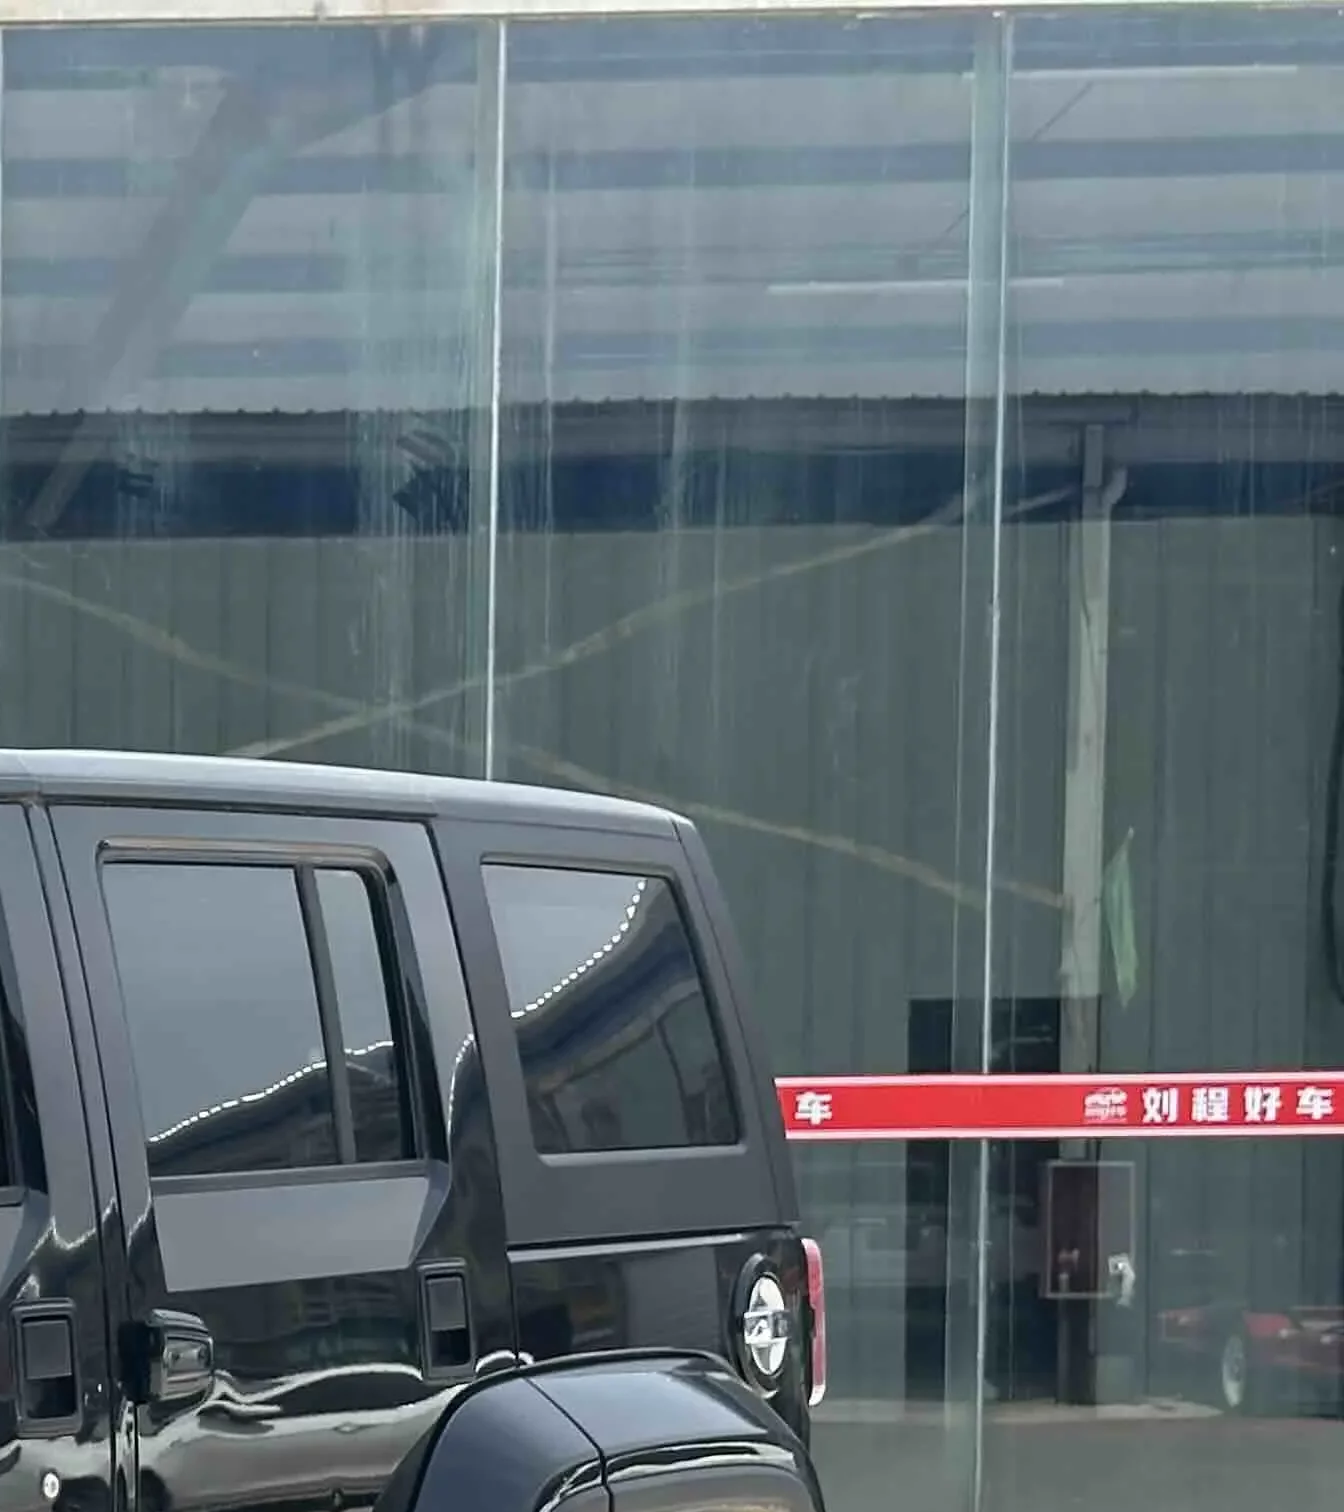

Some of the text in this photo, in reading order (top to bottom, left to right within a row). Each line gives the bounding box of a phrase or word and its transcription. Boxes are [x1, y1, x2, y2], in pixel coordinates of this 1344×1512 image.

[796, 1091, 832, 1126] 车
[1142, 1086, 1333, 1123] 刘程好车
